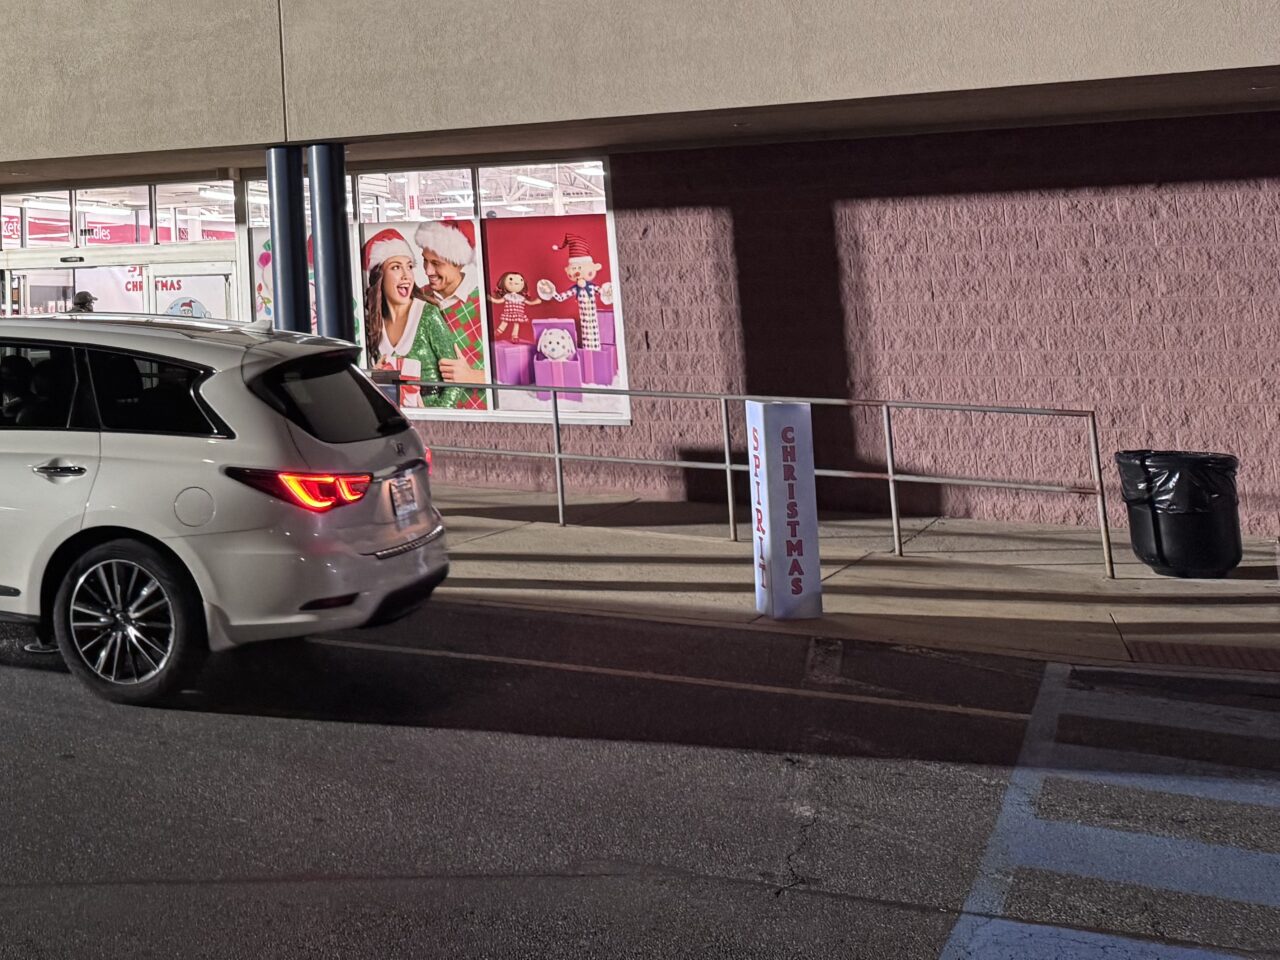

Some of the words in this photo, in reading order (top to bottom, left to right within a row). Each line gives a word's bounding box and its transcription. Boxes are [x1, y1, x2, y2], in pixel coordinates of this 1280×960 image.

[125, 279, 182, 292] CHRTMAS
[752, 426, 767, 589] SPIRIT
[781, 426, 805, 595] CHRISTMAS
